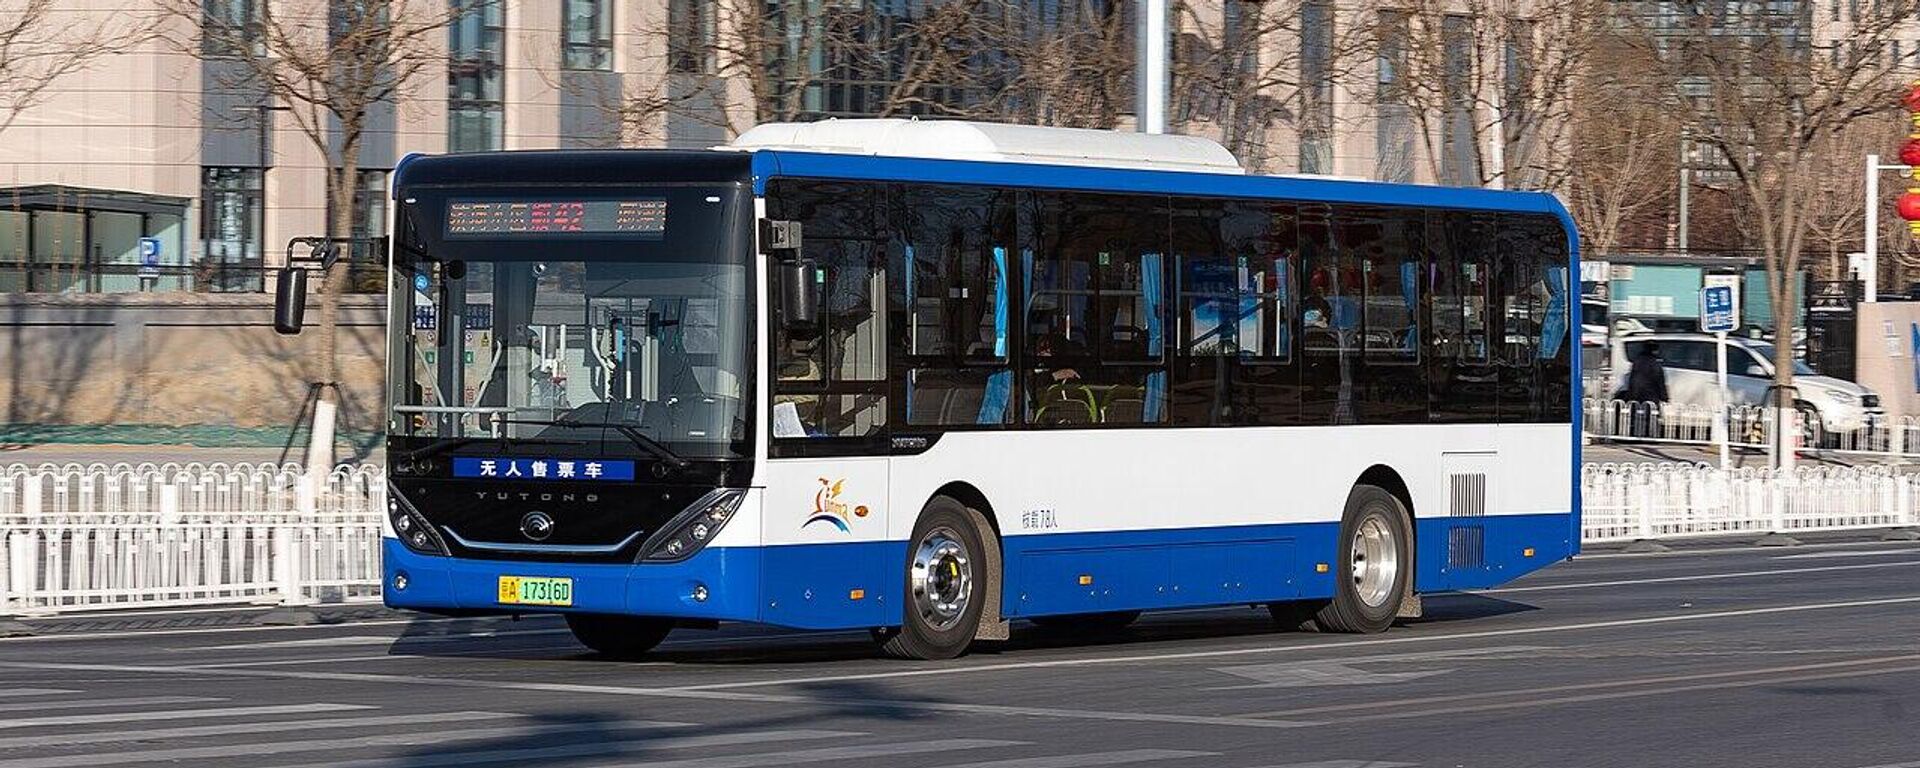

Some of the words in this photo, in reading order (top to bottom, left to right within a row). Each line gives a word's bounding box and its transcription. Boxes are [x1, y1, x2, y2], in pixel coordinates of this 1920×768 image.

[479, 460, 604, 479] 无人售票车
[475, 491, 599, 503] YUTONG
